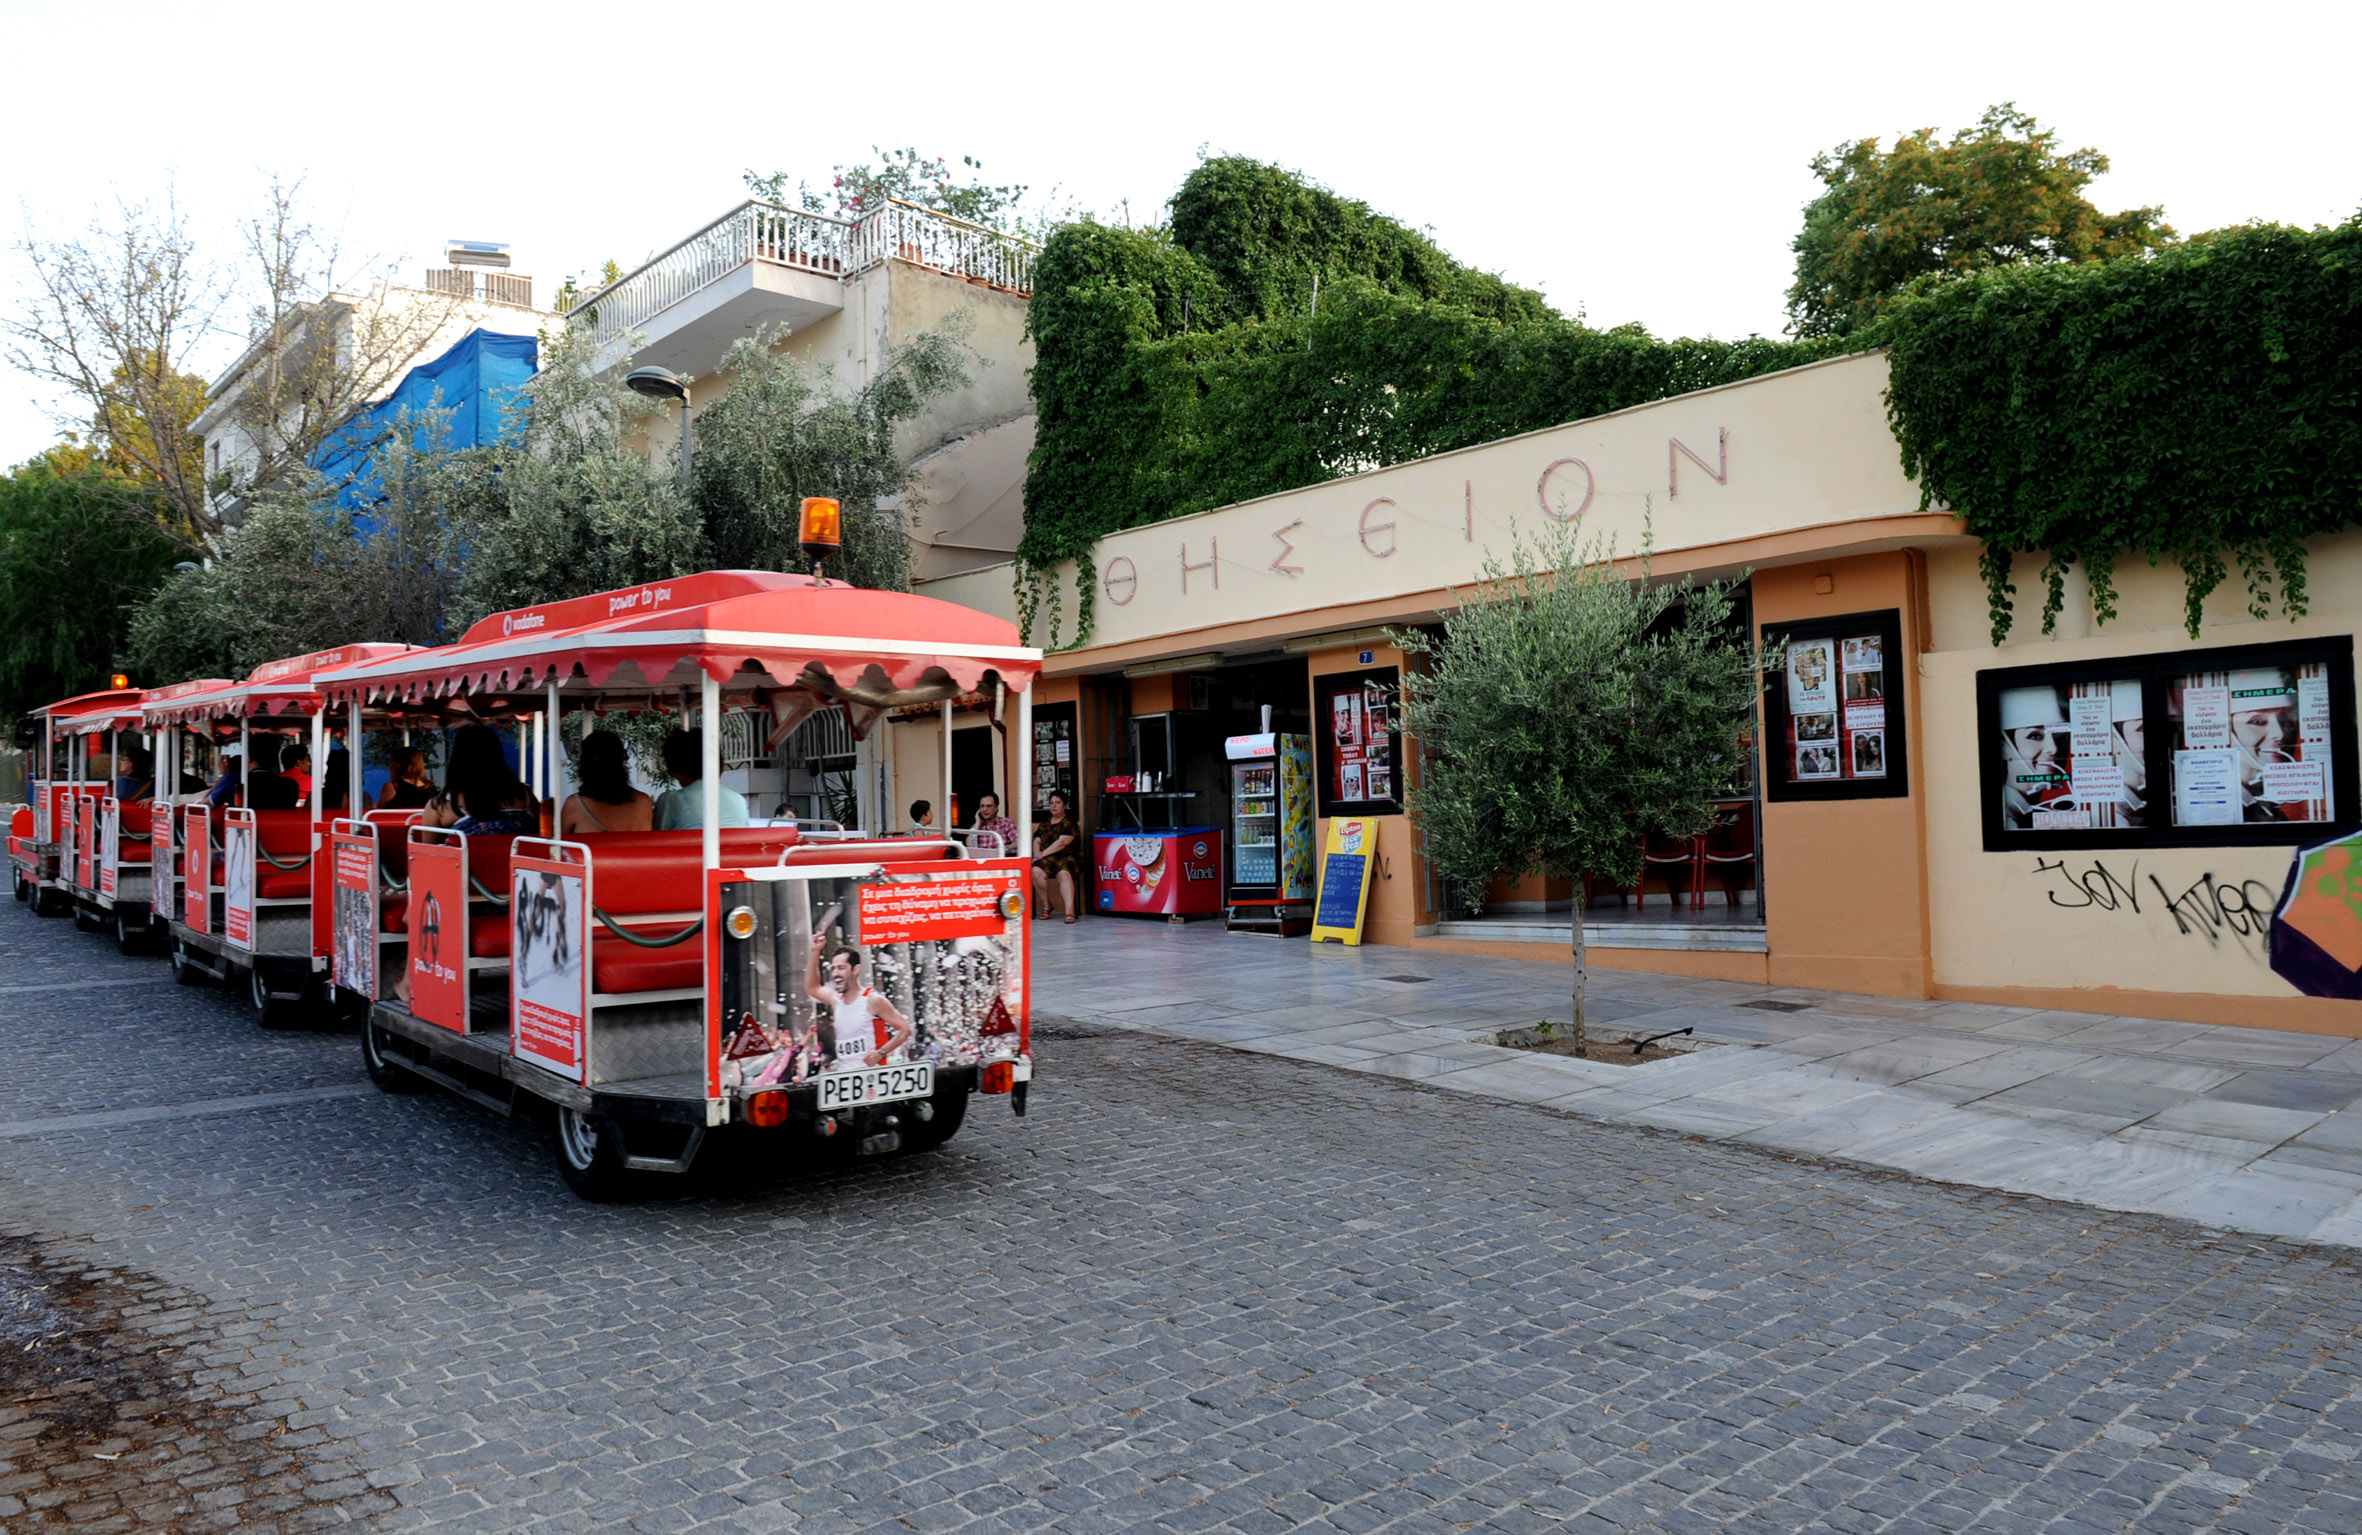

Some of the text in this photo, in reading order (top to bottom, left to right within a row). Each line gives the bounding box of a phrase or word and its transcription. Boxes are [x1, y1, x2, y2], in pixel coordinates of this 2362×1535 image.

[512, 586, 672, 631] vodafone power to you
[2233, 687, 2296, 698] ΣΗΜΕΡΑ
[1230, 736, 1250, 744] ΝΕΡΟ
[1252, 746, 1275, 756] WATER
[2018, 774, 2070, 782] ΣΗΜΕΡΑ
[1340, 824, 1362, 836] Lipton
[862, 888, 875, 899] Σε
[876, 888, 893, 900] μια
[942, 883, 971, 896] χωρίς
[939, 898, 952, 907] να
[862, 916, 877, 925] να
[928, 911, 942, 921] να
[434, 961, 444, 977] to
[443, 967, 457, 985] you
[838, 1038, 866, 1056] 4081
[878, 1067, 928, 1096] 5250
